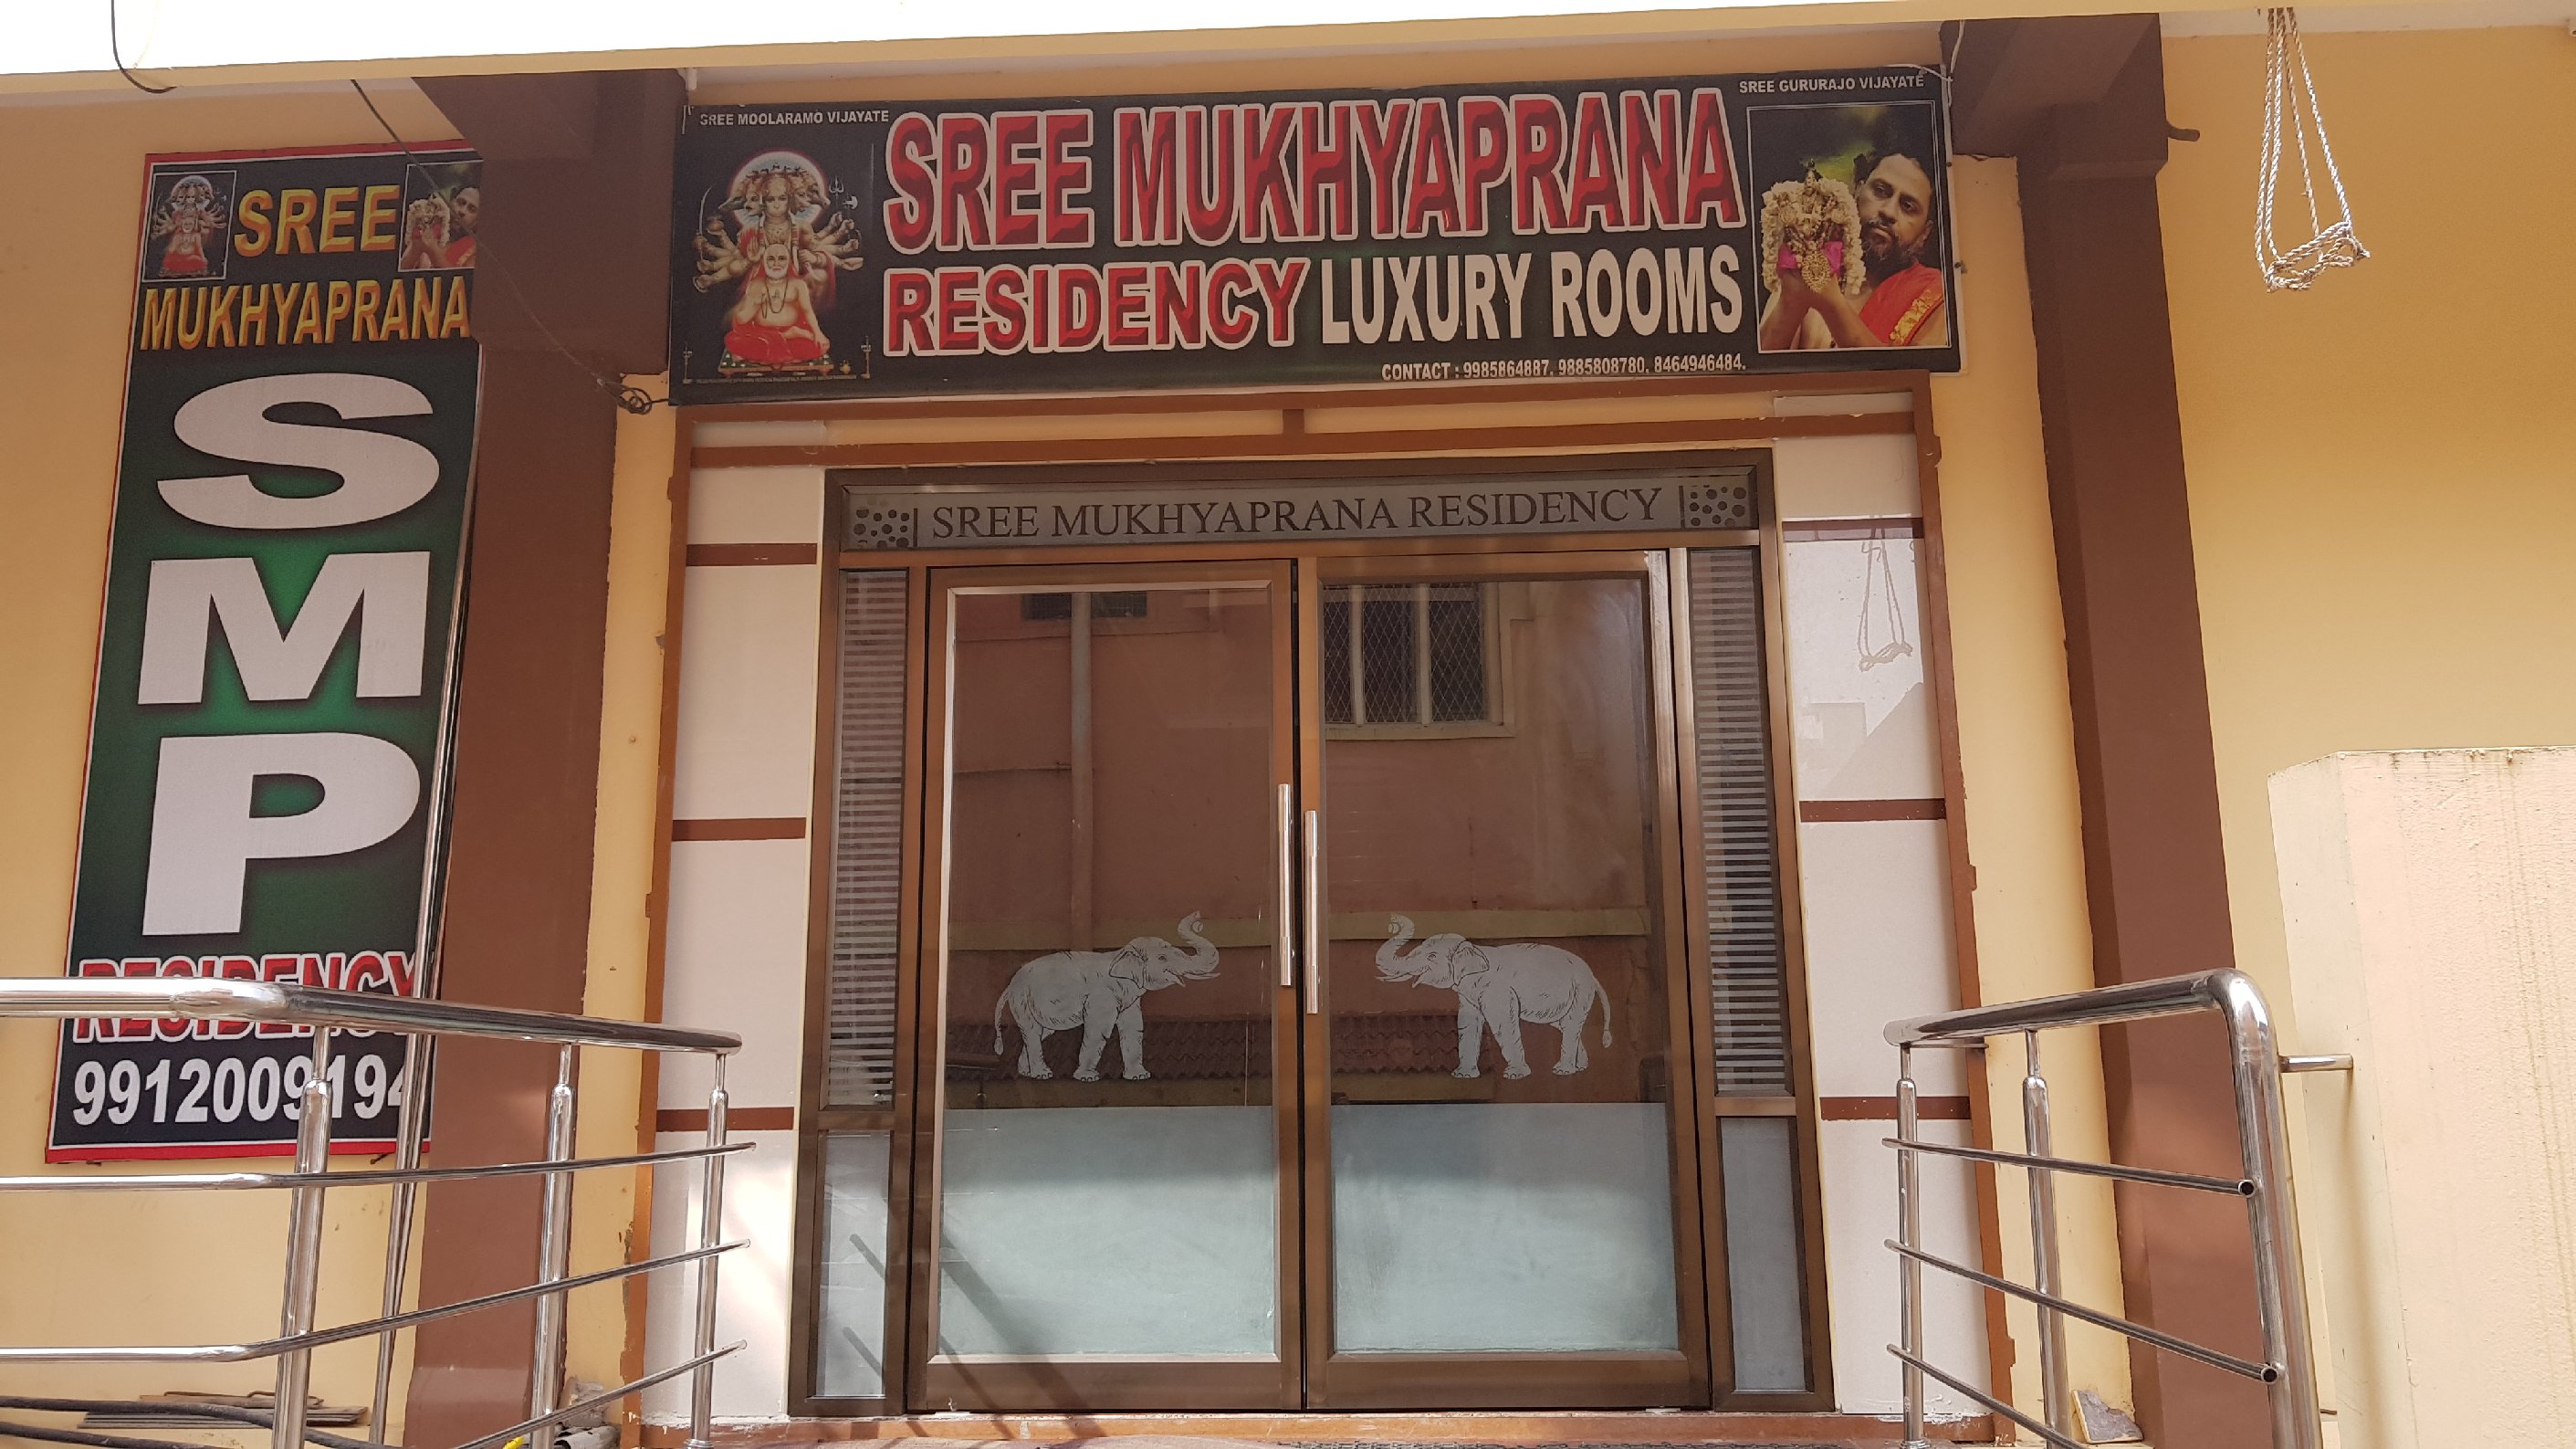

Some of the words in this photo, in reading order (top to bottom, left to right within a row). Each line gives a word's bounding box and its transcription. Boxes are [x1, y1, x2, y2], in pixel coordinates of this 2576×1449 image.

[699, 113, 734, 126] SREE
[738, 110, 823, 125] MOOLARAMO
[828, 110, 889, 123] VIJAYATE
[1739, 80, 1775, 93] SREE
[1779, 78, 1856, 92] GURURAJO
[1859, 75, 1925, 89] VIJAYATE
[884, 110, 1094, 254] SREE
[1113, 88, 1746, 247] MUKHYAPRANA
[234, 184, 401, 257] SREE
[140, 276, 470, 351] MUKHYAPRANA
[884, 258, 1312, 357] RESIDENCY
[1321, 253, 1532, 345] LUXURY
[1552, 245, 1744, 340] ROOMS
[1381, 362, 1451, 381] CONTACT
[933, 504, 1039, 539] SREE
[1052, 497, 1398, 537] MUKHYAPRANA
[1408, 487, 1662, 527] RESIDENCY
[137, 373, 440, 937] SMP
